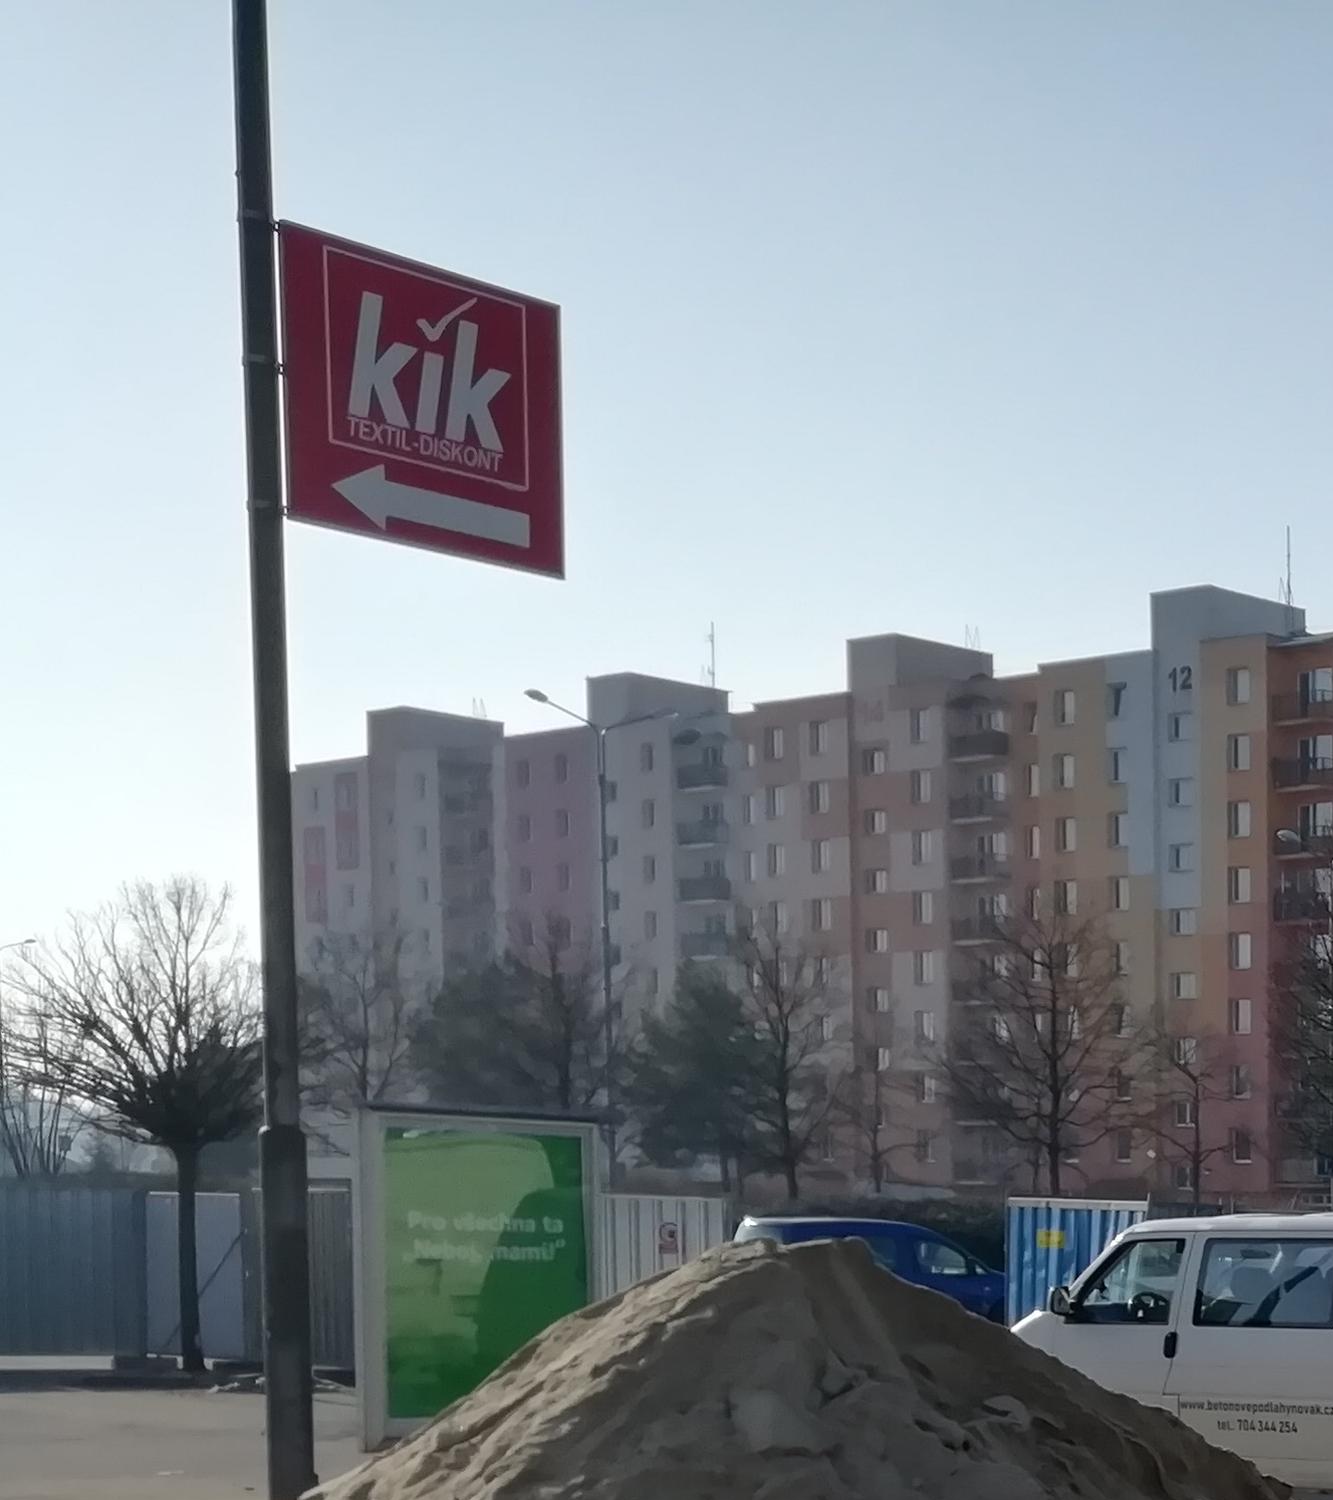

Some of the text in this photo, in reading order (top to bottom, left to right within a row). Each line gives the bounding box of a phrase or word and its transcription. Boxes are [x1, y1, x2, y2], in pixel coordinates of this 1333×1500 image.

[347, 290, 512, 453] kik
[346, 416, 504, 473] TEXTIL-DISKONT
[1168, 665, 1193, 693] 12
[408, 1210, 447, 1230] Pro
[543, 1216, 564, 1234] ta
[1237, 1419, 1255, 1432] 704
[1258, 1420, 1277, 1433] 344
[1279, 1421, 1298, 1434] 254
